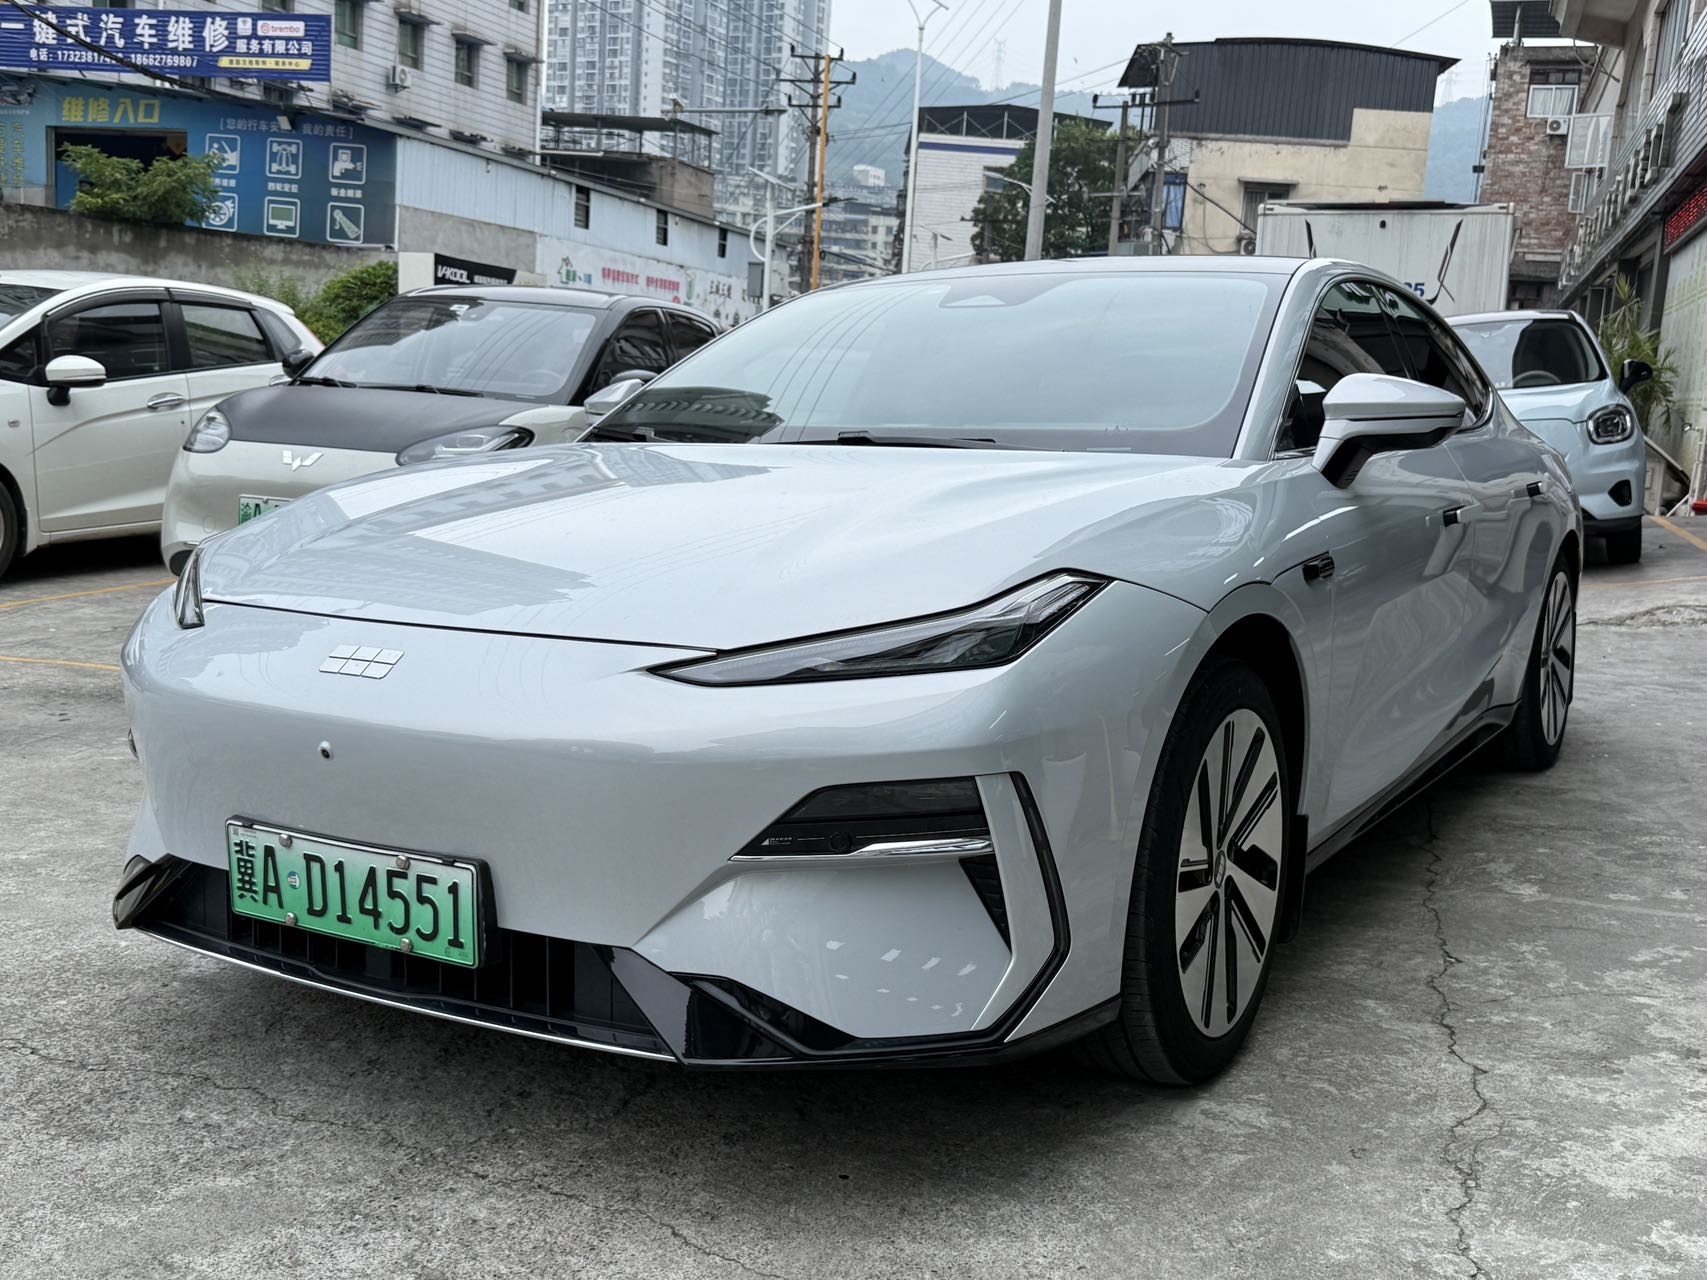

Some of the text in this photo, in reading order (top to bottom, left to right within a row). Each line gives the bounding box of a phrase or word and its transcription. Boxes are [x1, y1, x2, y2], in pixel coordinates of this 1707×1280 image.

[1, 11, 229, 53] 一键式汽车维修
[271, 24, 300, 33] brembo
[236, 39, 313, 55] 服务有限公司
[62, 96, 161, 124] 维修入口
